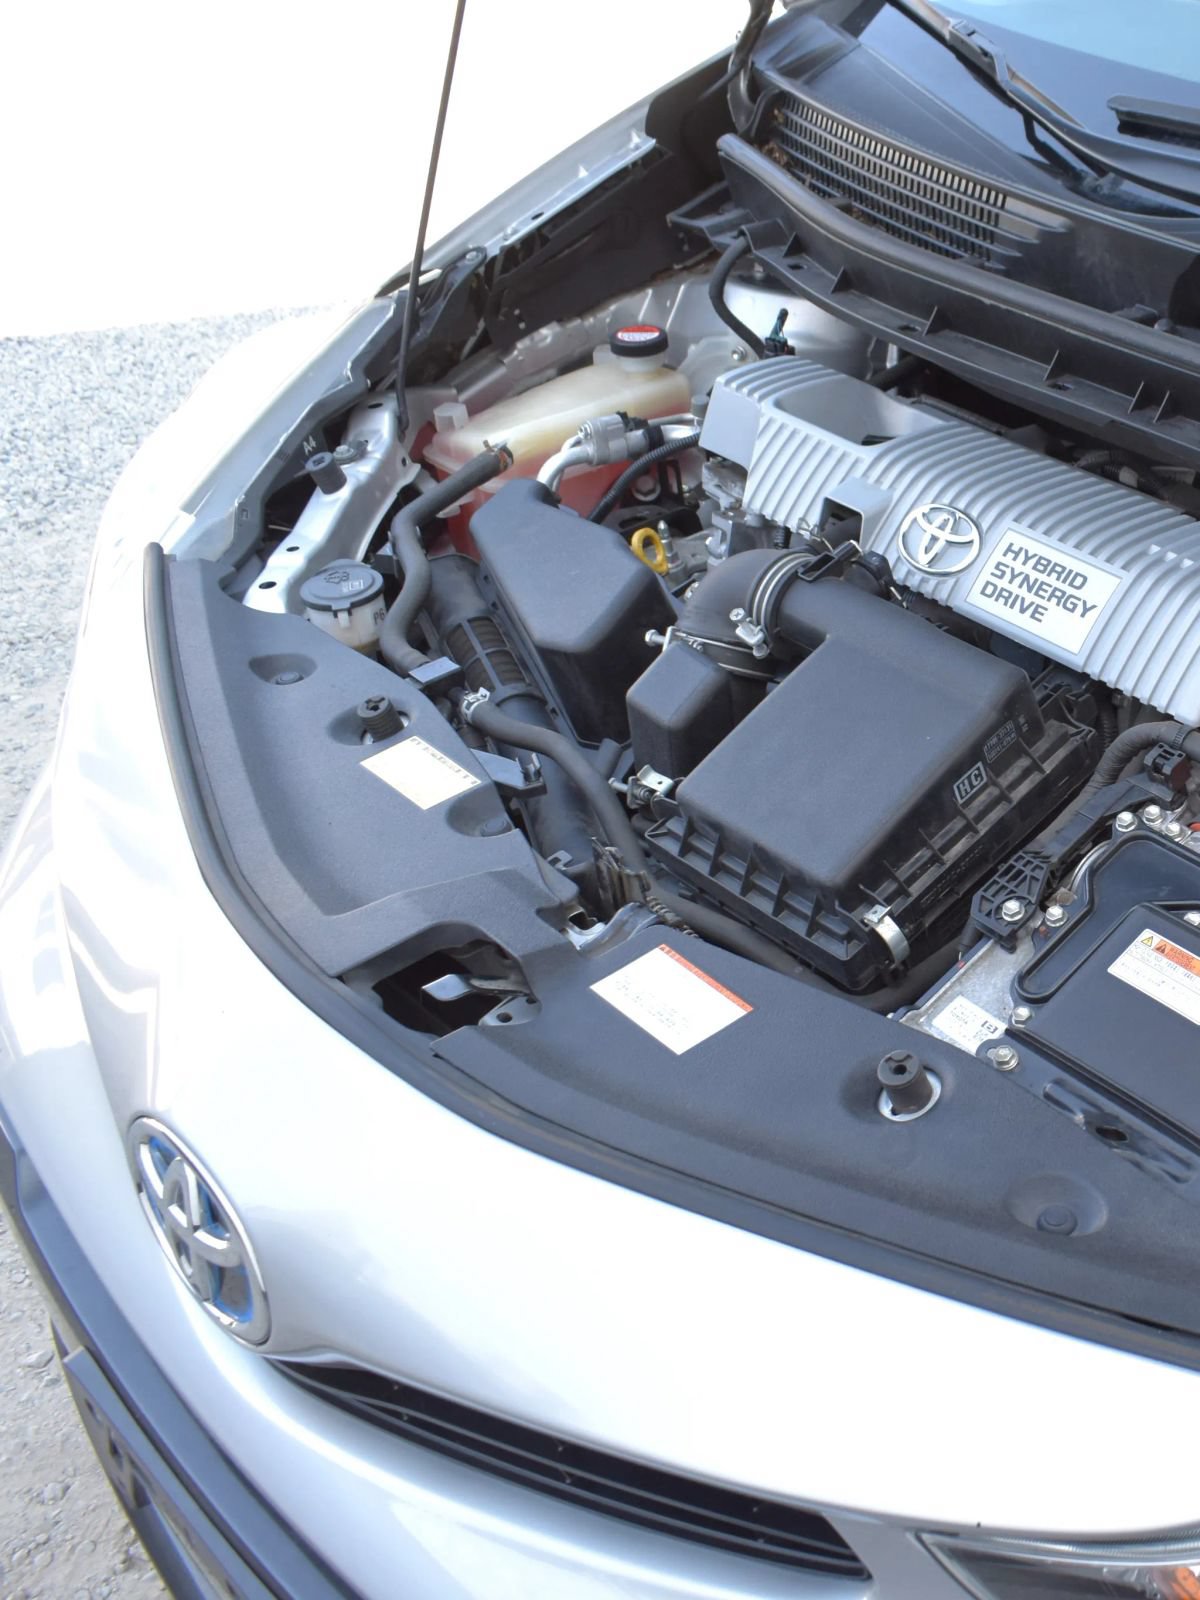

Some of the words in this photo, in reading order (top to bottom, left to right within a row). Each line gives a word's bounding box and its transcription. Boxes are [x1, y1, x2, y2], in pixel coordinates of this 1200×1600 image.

[1002, 542, 1088, 591] HYBRID
[980, 581, 1048, 623] DRIVE
[990, 561, 1097, 618] SYNERGY
[958, 769, 982, 798] HC
